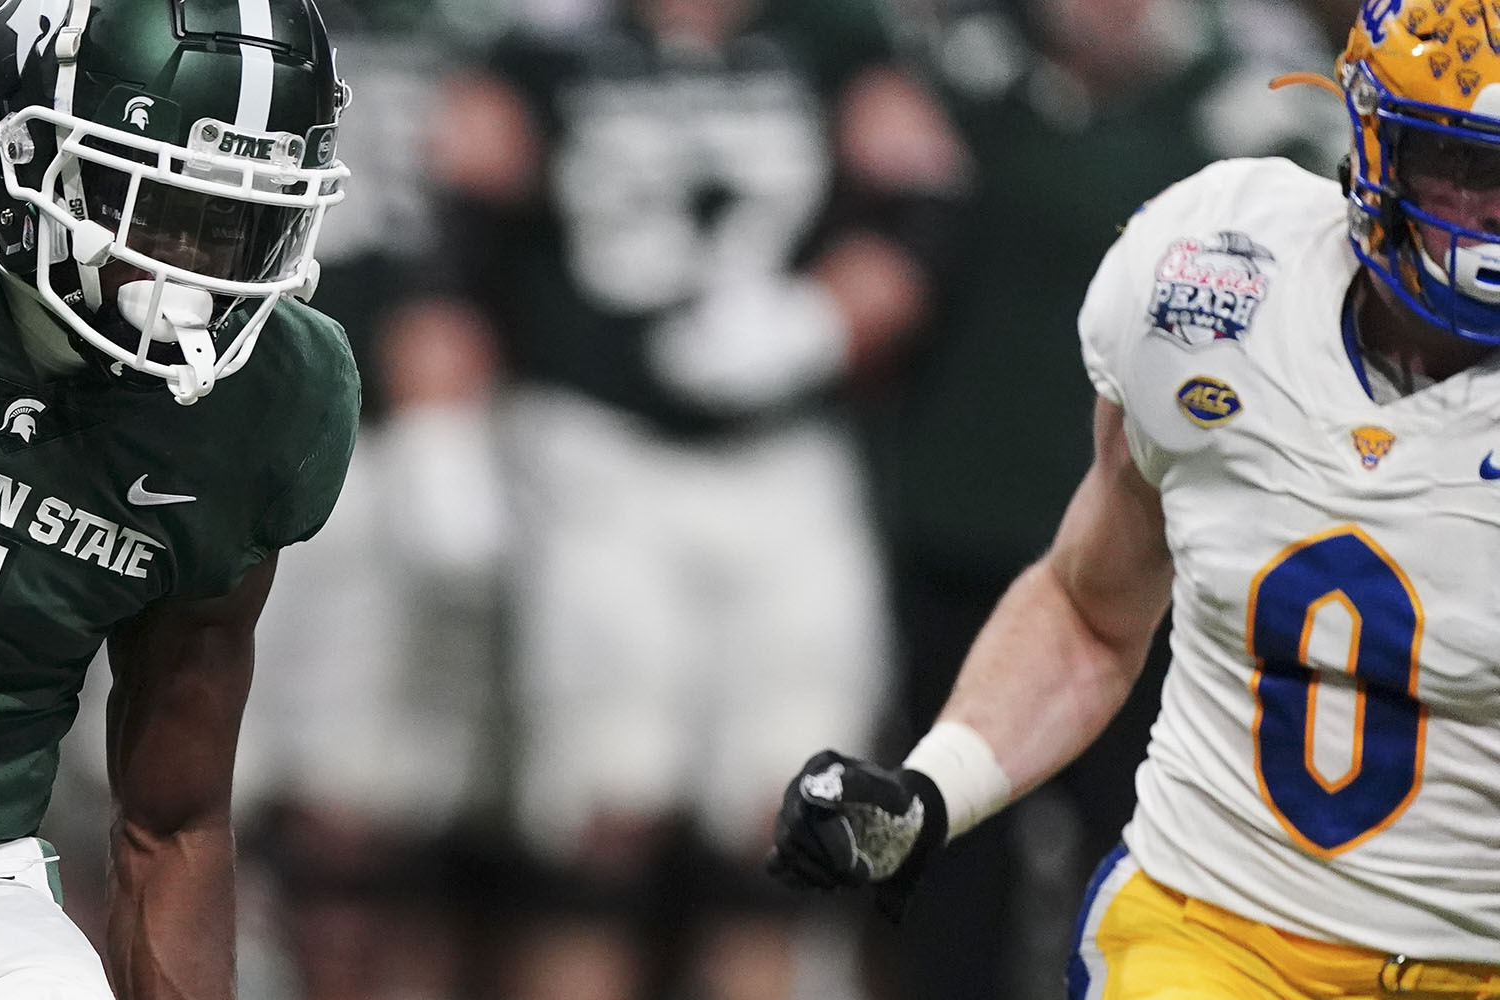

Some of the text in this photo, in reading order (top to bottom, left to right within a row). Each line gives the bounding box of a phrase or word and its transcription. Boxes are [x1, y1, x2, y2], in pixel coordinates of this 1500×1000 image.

[1180, 385, 1234, 416] ACC
[27, 496, 168, 579] STATE
[1246, 522, 1427, 858] 0
